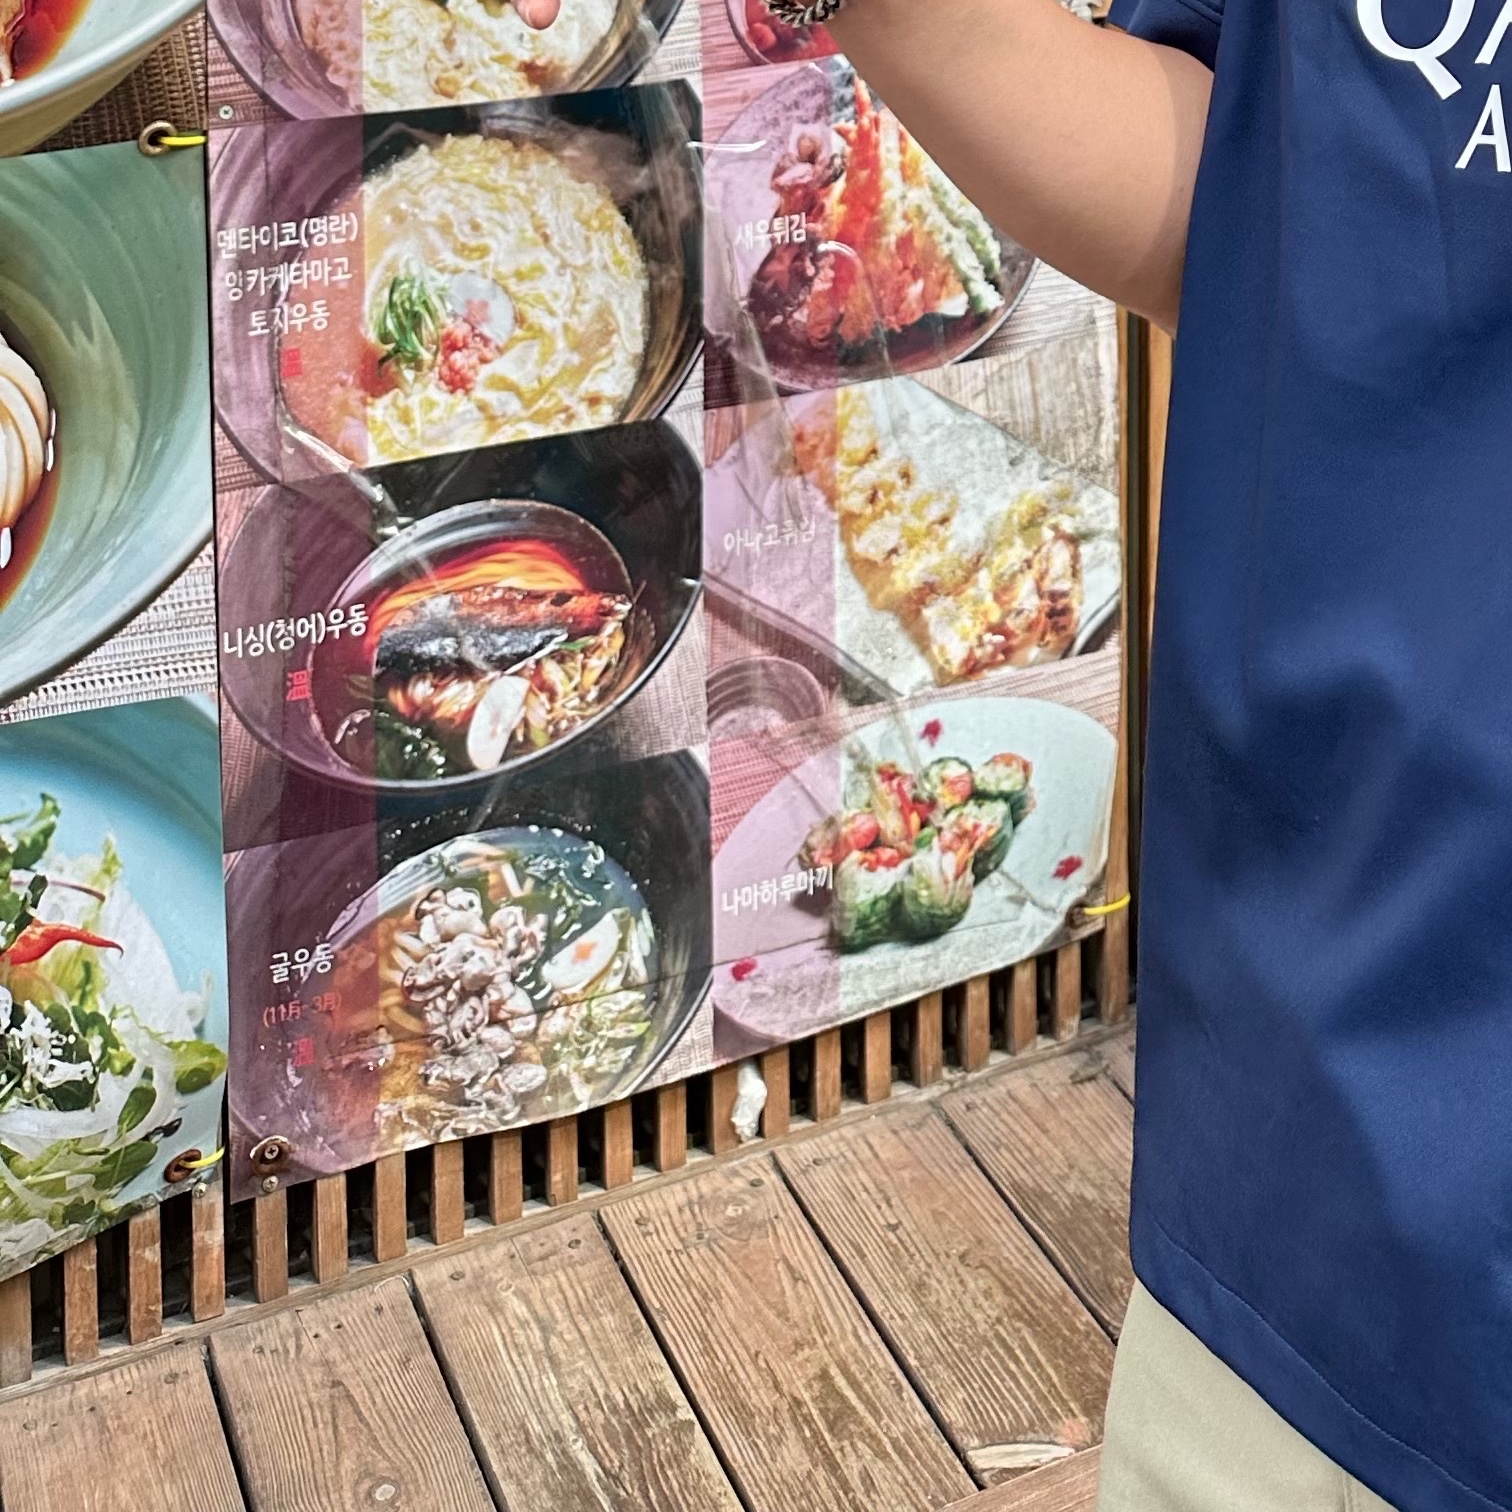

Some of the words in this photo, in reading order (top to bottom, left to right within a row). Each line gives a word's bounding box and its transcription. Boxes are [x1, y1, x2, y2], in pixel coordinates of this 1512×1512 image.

[216, 212, 358, 259] 멘타이코(명란)
[734, 212, 807, 250] 새우튀김
[247, 300, 331, 336] 토지우동
[223, 603, 369, 658] 니싱(청어)우동
[721, 863, 834, 915] 나마하루마끼
[269, 943, 335, 984] 굴우동
